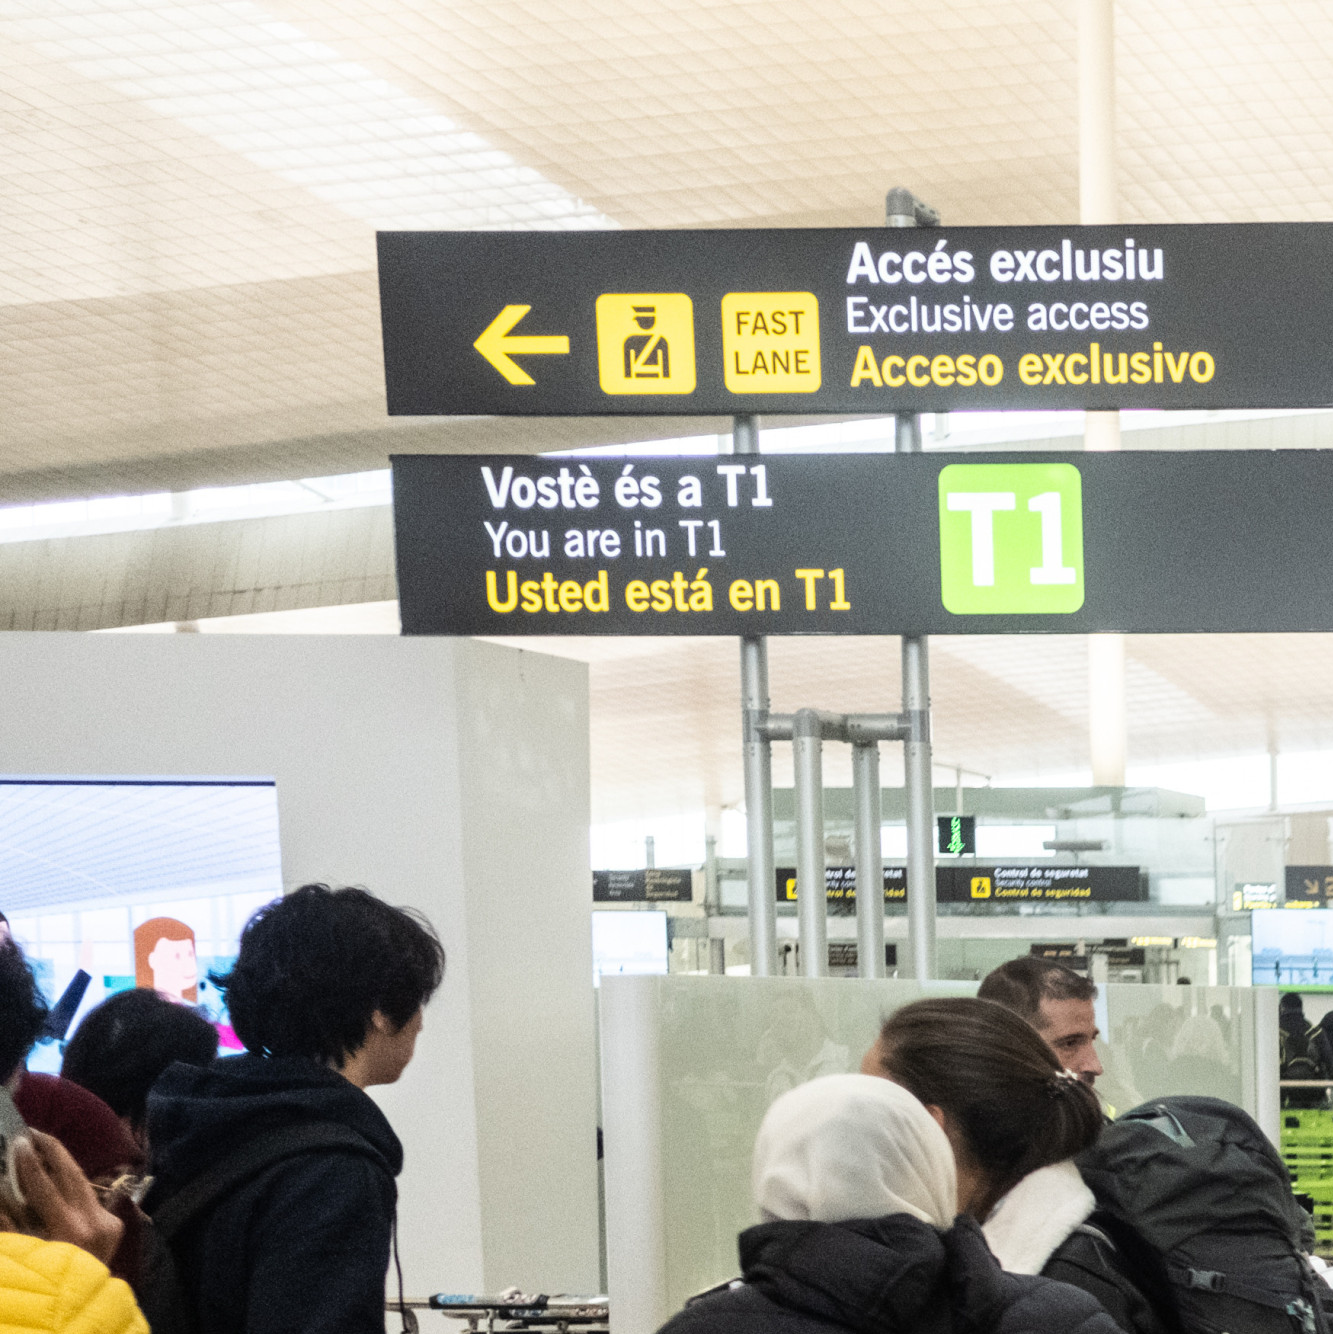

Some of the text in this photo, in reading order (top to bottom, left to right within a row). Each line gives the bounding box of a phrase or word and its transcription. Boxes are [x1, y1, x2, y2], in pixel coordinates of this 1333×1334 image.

[846, 238, 1164, 285] Accés exclusiu
[736, 311, 804, 335] FAST
[846, 295, 1149, 334] Exclusive access
[735, 350, 810, 375] LANE
[850, 342, 1215, 388] Acceso exclusivo
[481, 463, 773, 509] Vostè és a T1
[484, 519, 726, 558] You are in T1
[947, 491, 1077, 586] T1
[486, 568, 851, 613] Usted está en T1
